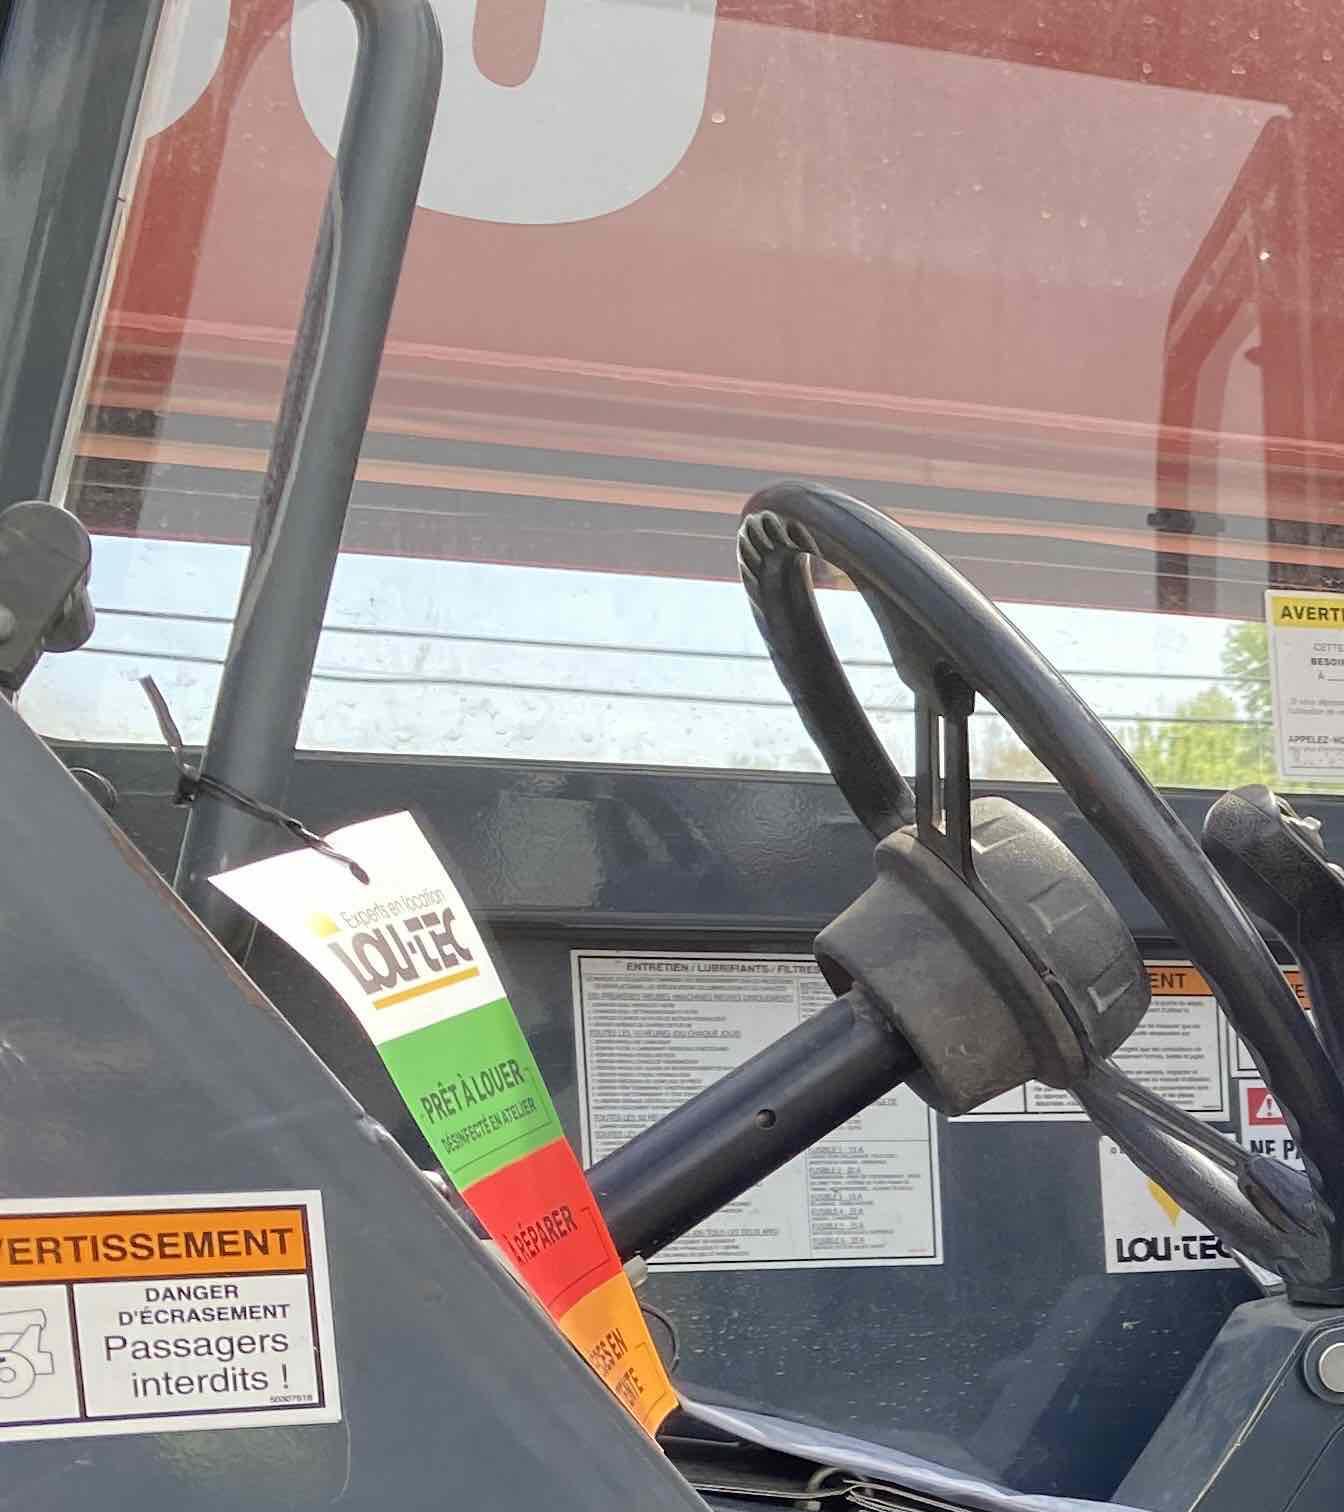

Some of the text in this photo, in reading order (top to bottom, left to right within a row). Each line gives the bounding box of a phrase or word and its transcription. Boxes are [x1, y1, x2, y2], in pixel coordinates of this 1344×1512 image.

[340, 902, 388, 929] Experts
[400, 888, 446, 912] location
[327, 907, 474, 995] LOU-TEC
[626, 961, 689, 973] ENTRETIEN
[420, 1080, 463, 1125] PRÊT
[471, 1058, 525, 1102] LOUER
[502, 1096, 537, 1126] ATELIER
[0, 1228, 294, 1266] ERTISSEMENT
[145, 1284, 240, 1303] DANGER
[118, 1303, 291, 1328] D'ÉCRASEMENT
[103, 1332, 289, 1363] Passagers
[131, 1367, 270, 1398] interdits
